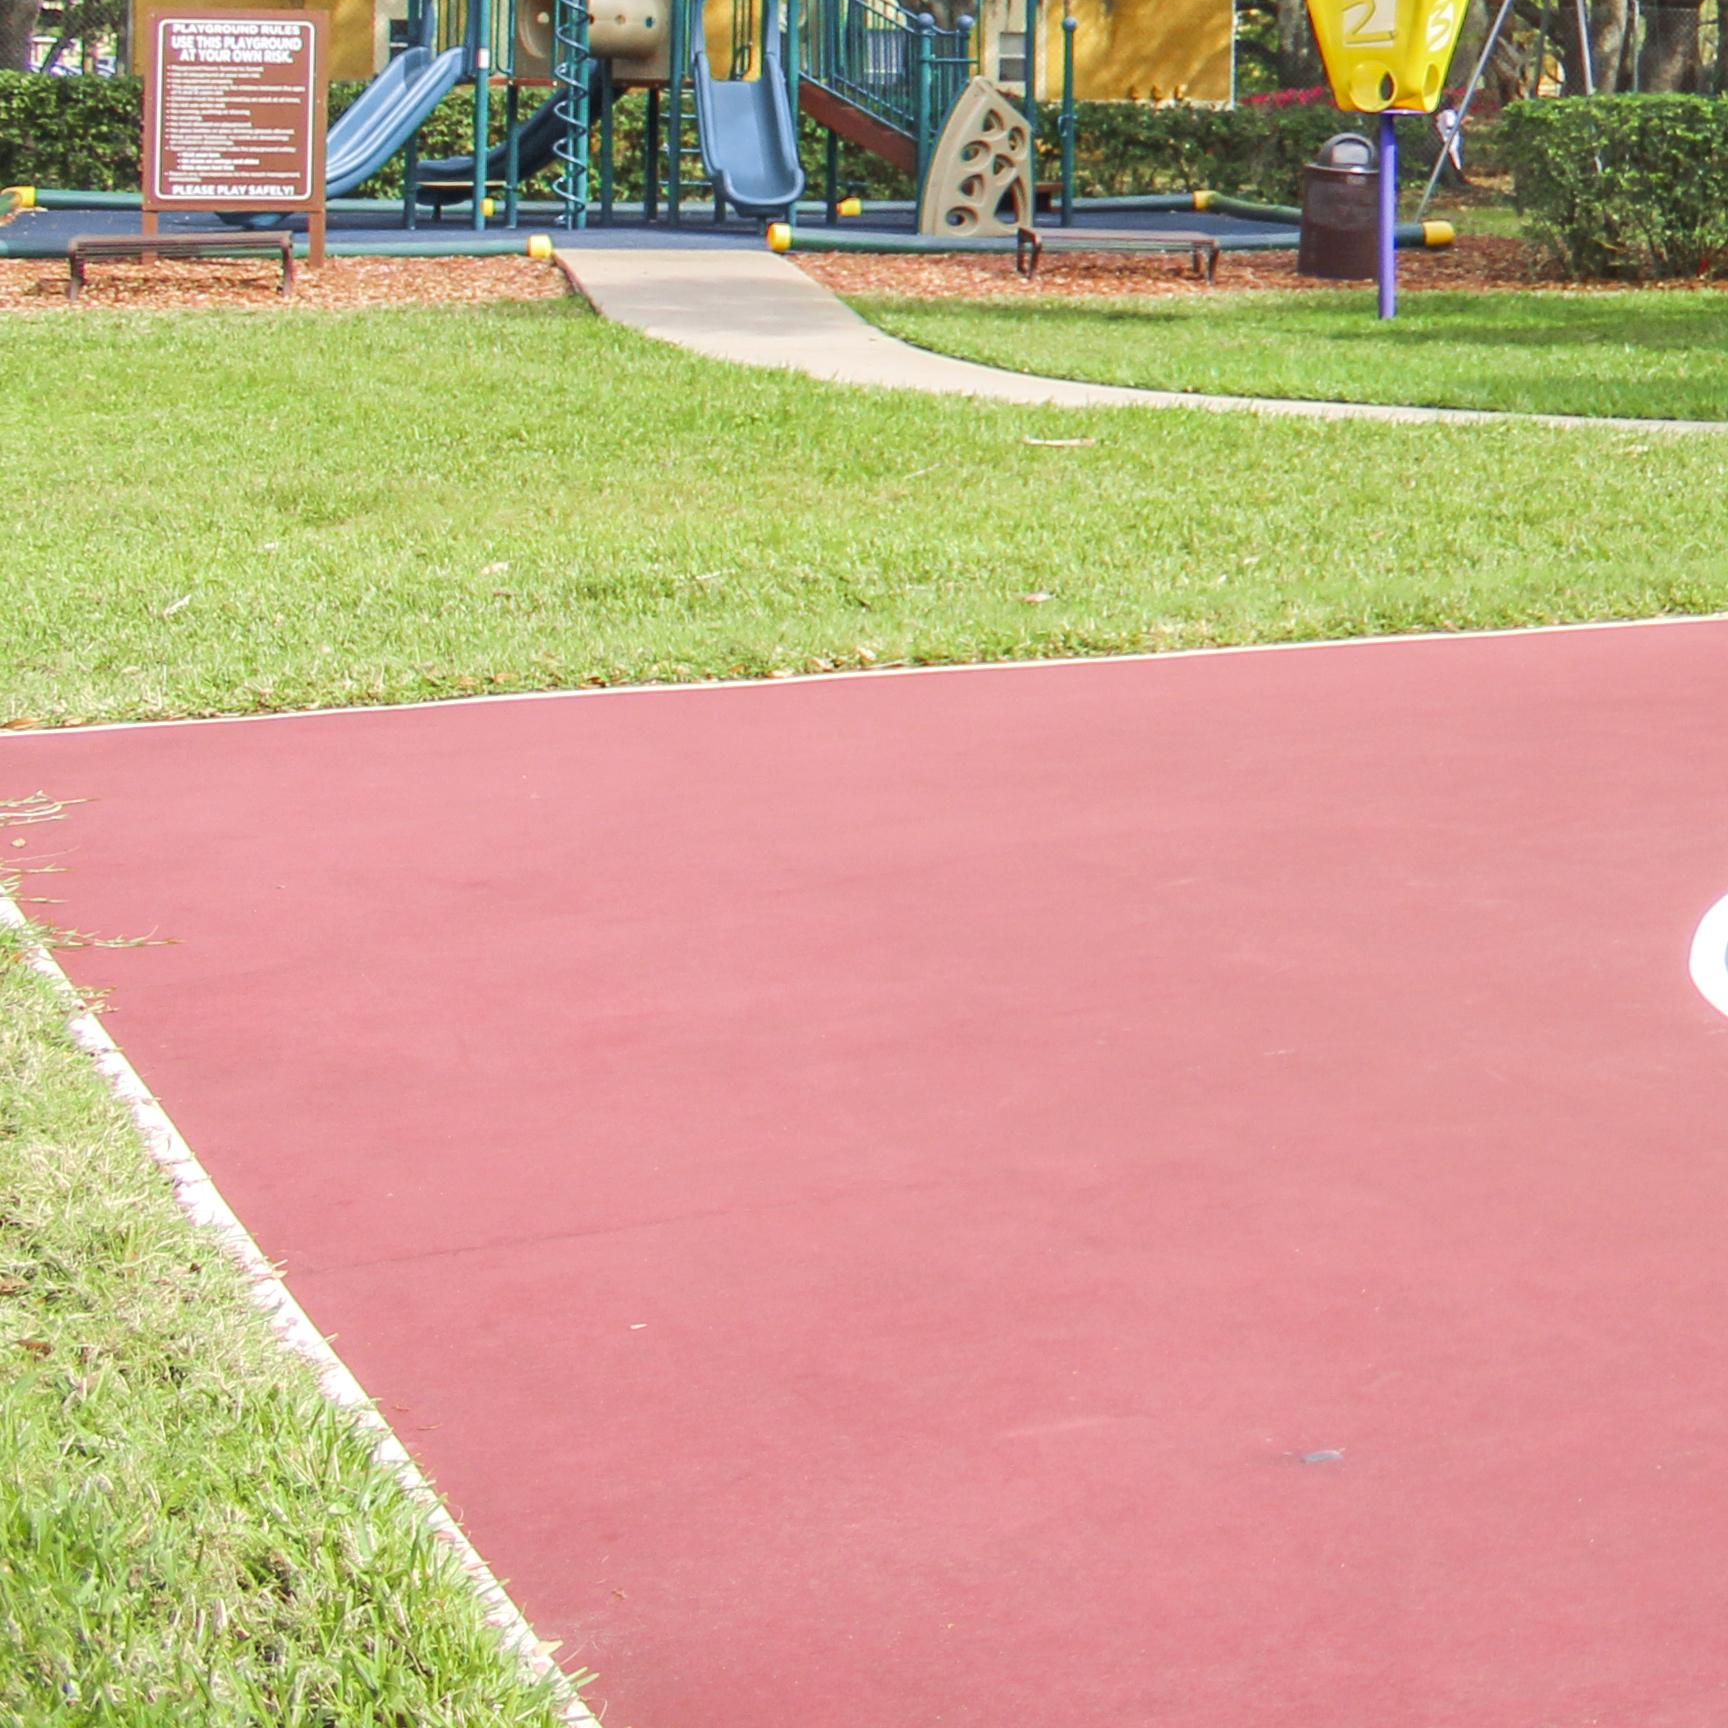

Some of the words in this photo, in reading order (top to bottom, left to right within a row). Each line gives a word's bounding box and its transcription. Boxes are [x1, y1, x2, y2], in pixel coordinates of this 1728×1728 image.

[172, 23, 259, 34] PLAYGROUND
[260, 25, 301, 35] RULES
[1428, 0, 1453, 47] 3
[171, 35, 196, 49] USE
[196, 36, 222, 49] THIS
[223, 37, 303, 51] PLAYGROUND
[179, 50, 196, 62] AT
[199, 50, 232, 62] YOUR
[232, 50, 262, 62] OWN
[172, 185, 215, 195] PLEASE
[217, 185, 248, 195] PLAY
[249, 185, 294, 195] SAFELY!
